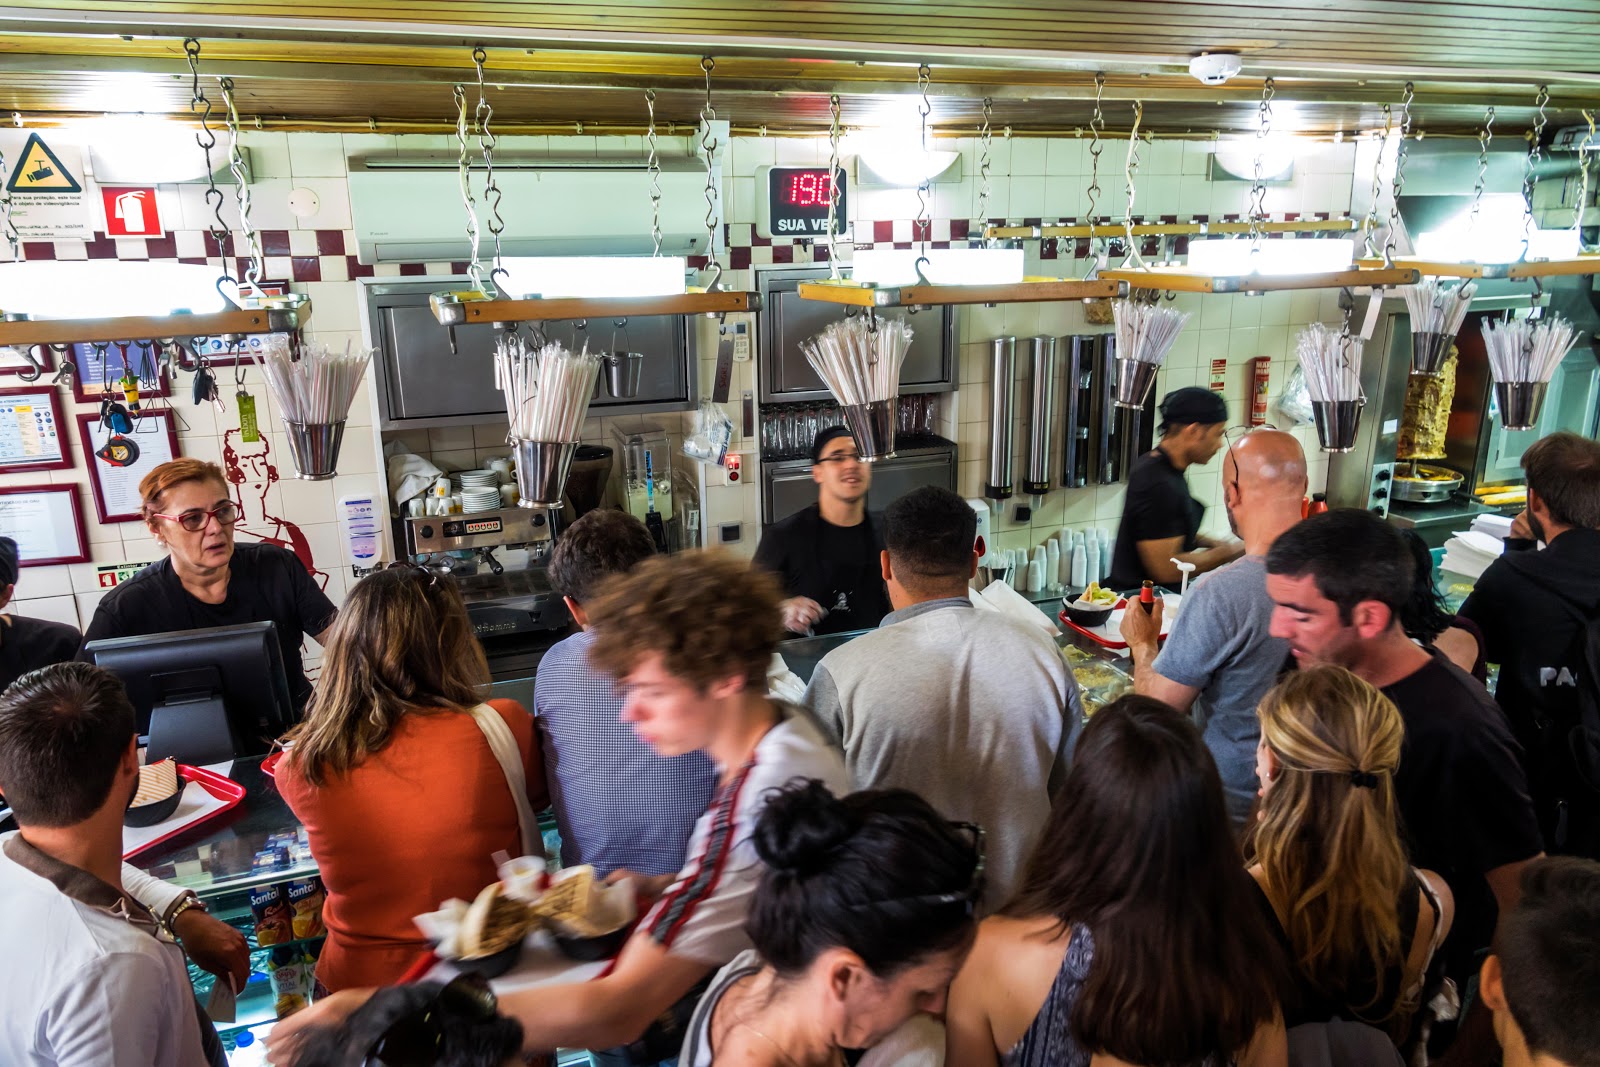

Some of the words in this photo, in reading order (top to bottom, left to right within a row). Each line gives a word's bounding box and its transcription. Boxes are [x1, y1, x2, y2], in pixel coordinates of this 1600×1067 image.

[778, 219, 807, 231] SUA
[811, 219, 839, 232] VE
[1540, 666, 1578, 687] PA
[251, 887, 280, 906] Santal
[288, 880, 317, 898] Santal
